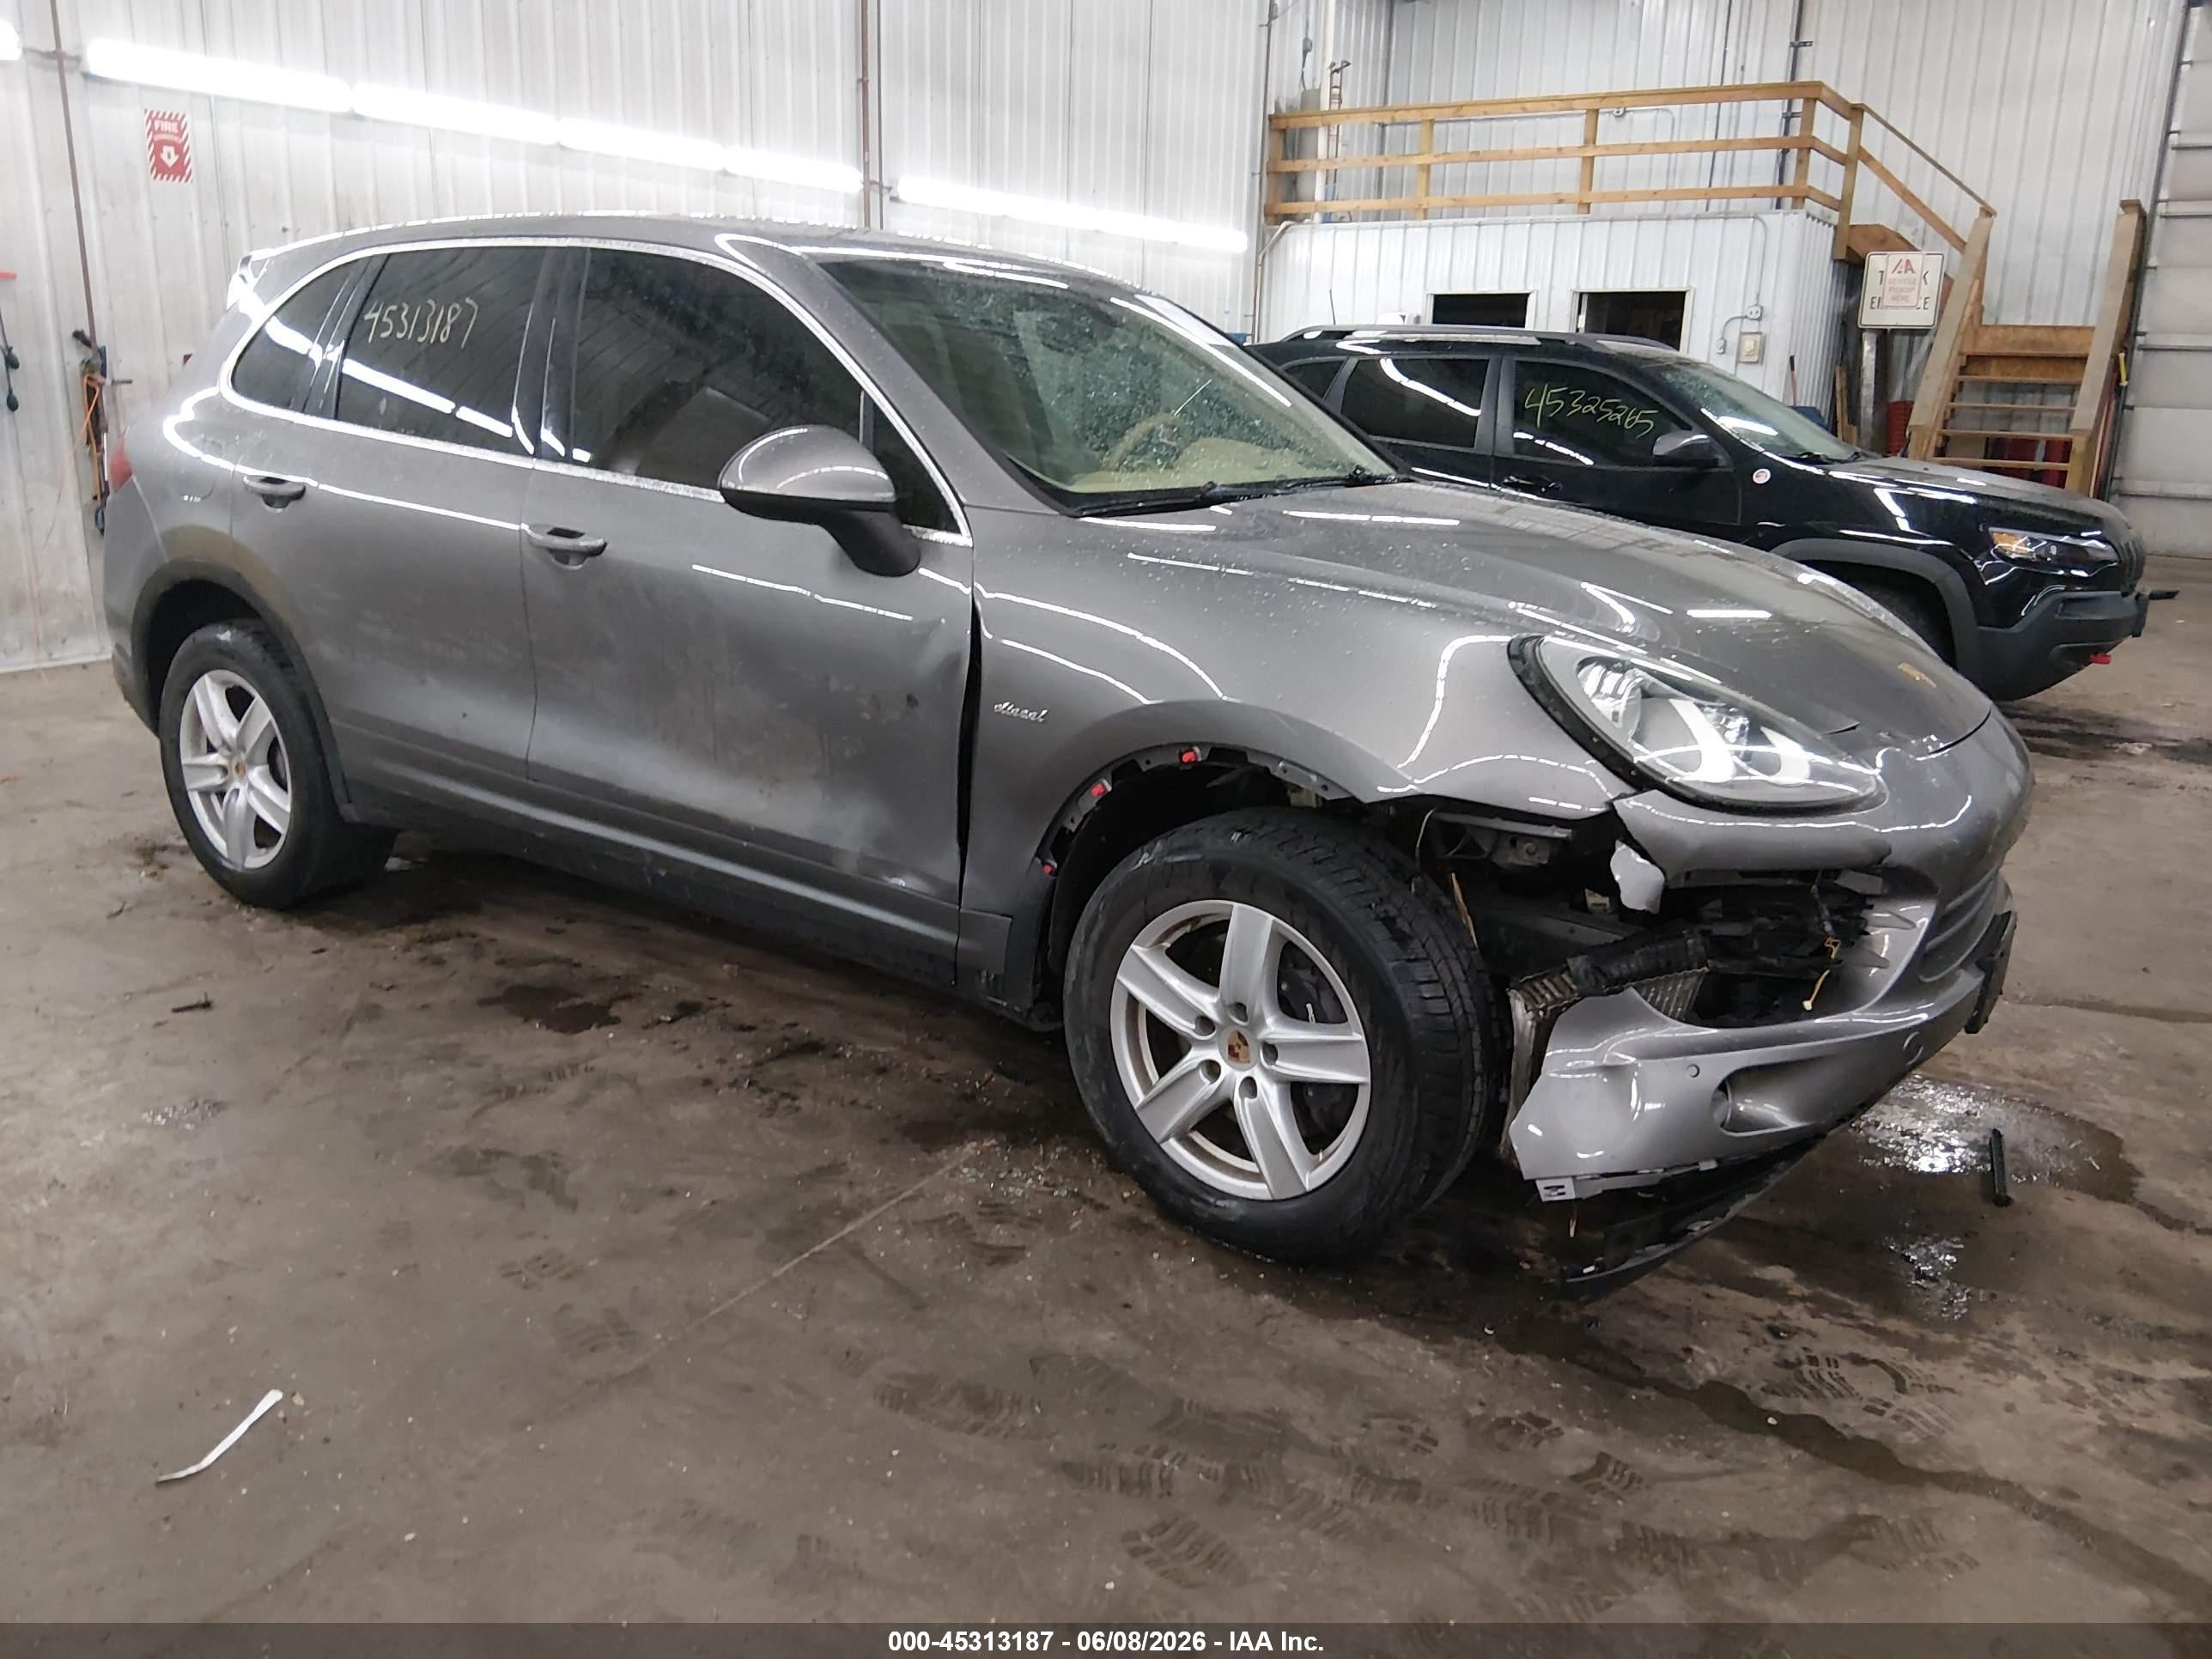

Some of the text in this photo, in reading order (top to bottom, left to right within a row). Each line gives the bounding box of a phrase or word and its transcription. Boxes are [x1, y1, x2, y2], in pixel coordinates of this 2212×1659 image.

[154, 119, 179, 134] FIRE
[364, 297, 478, 349] 45313187
[1524, 382, 1659, 440] 45325265
